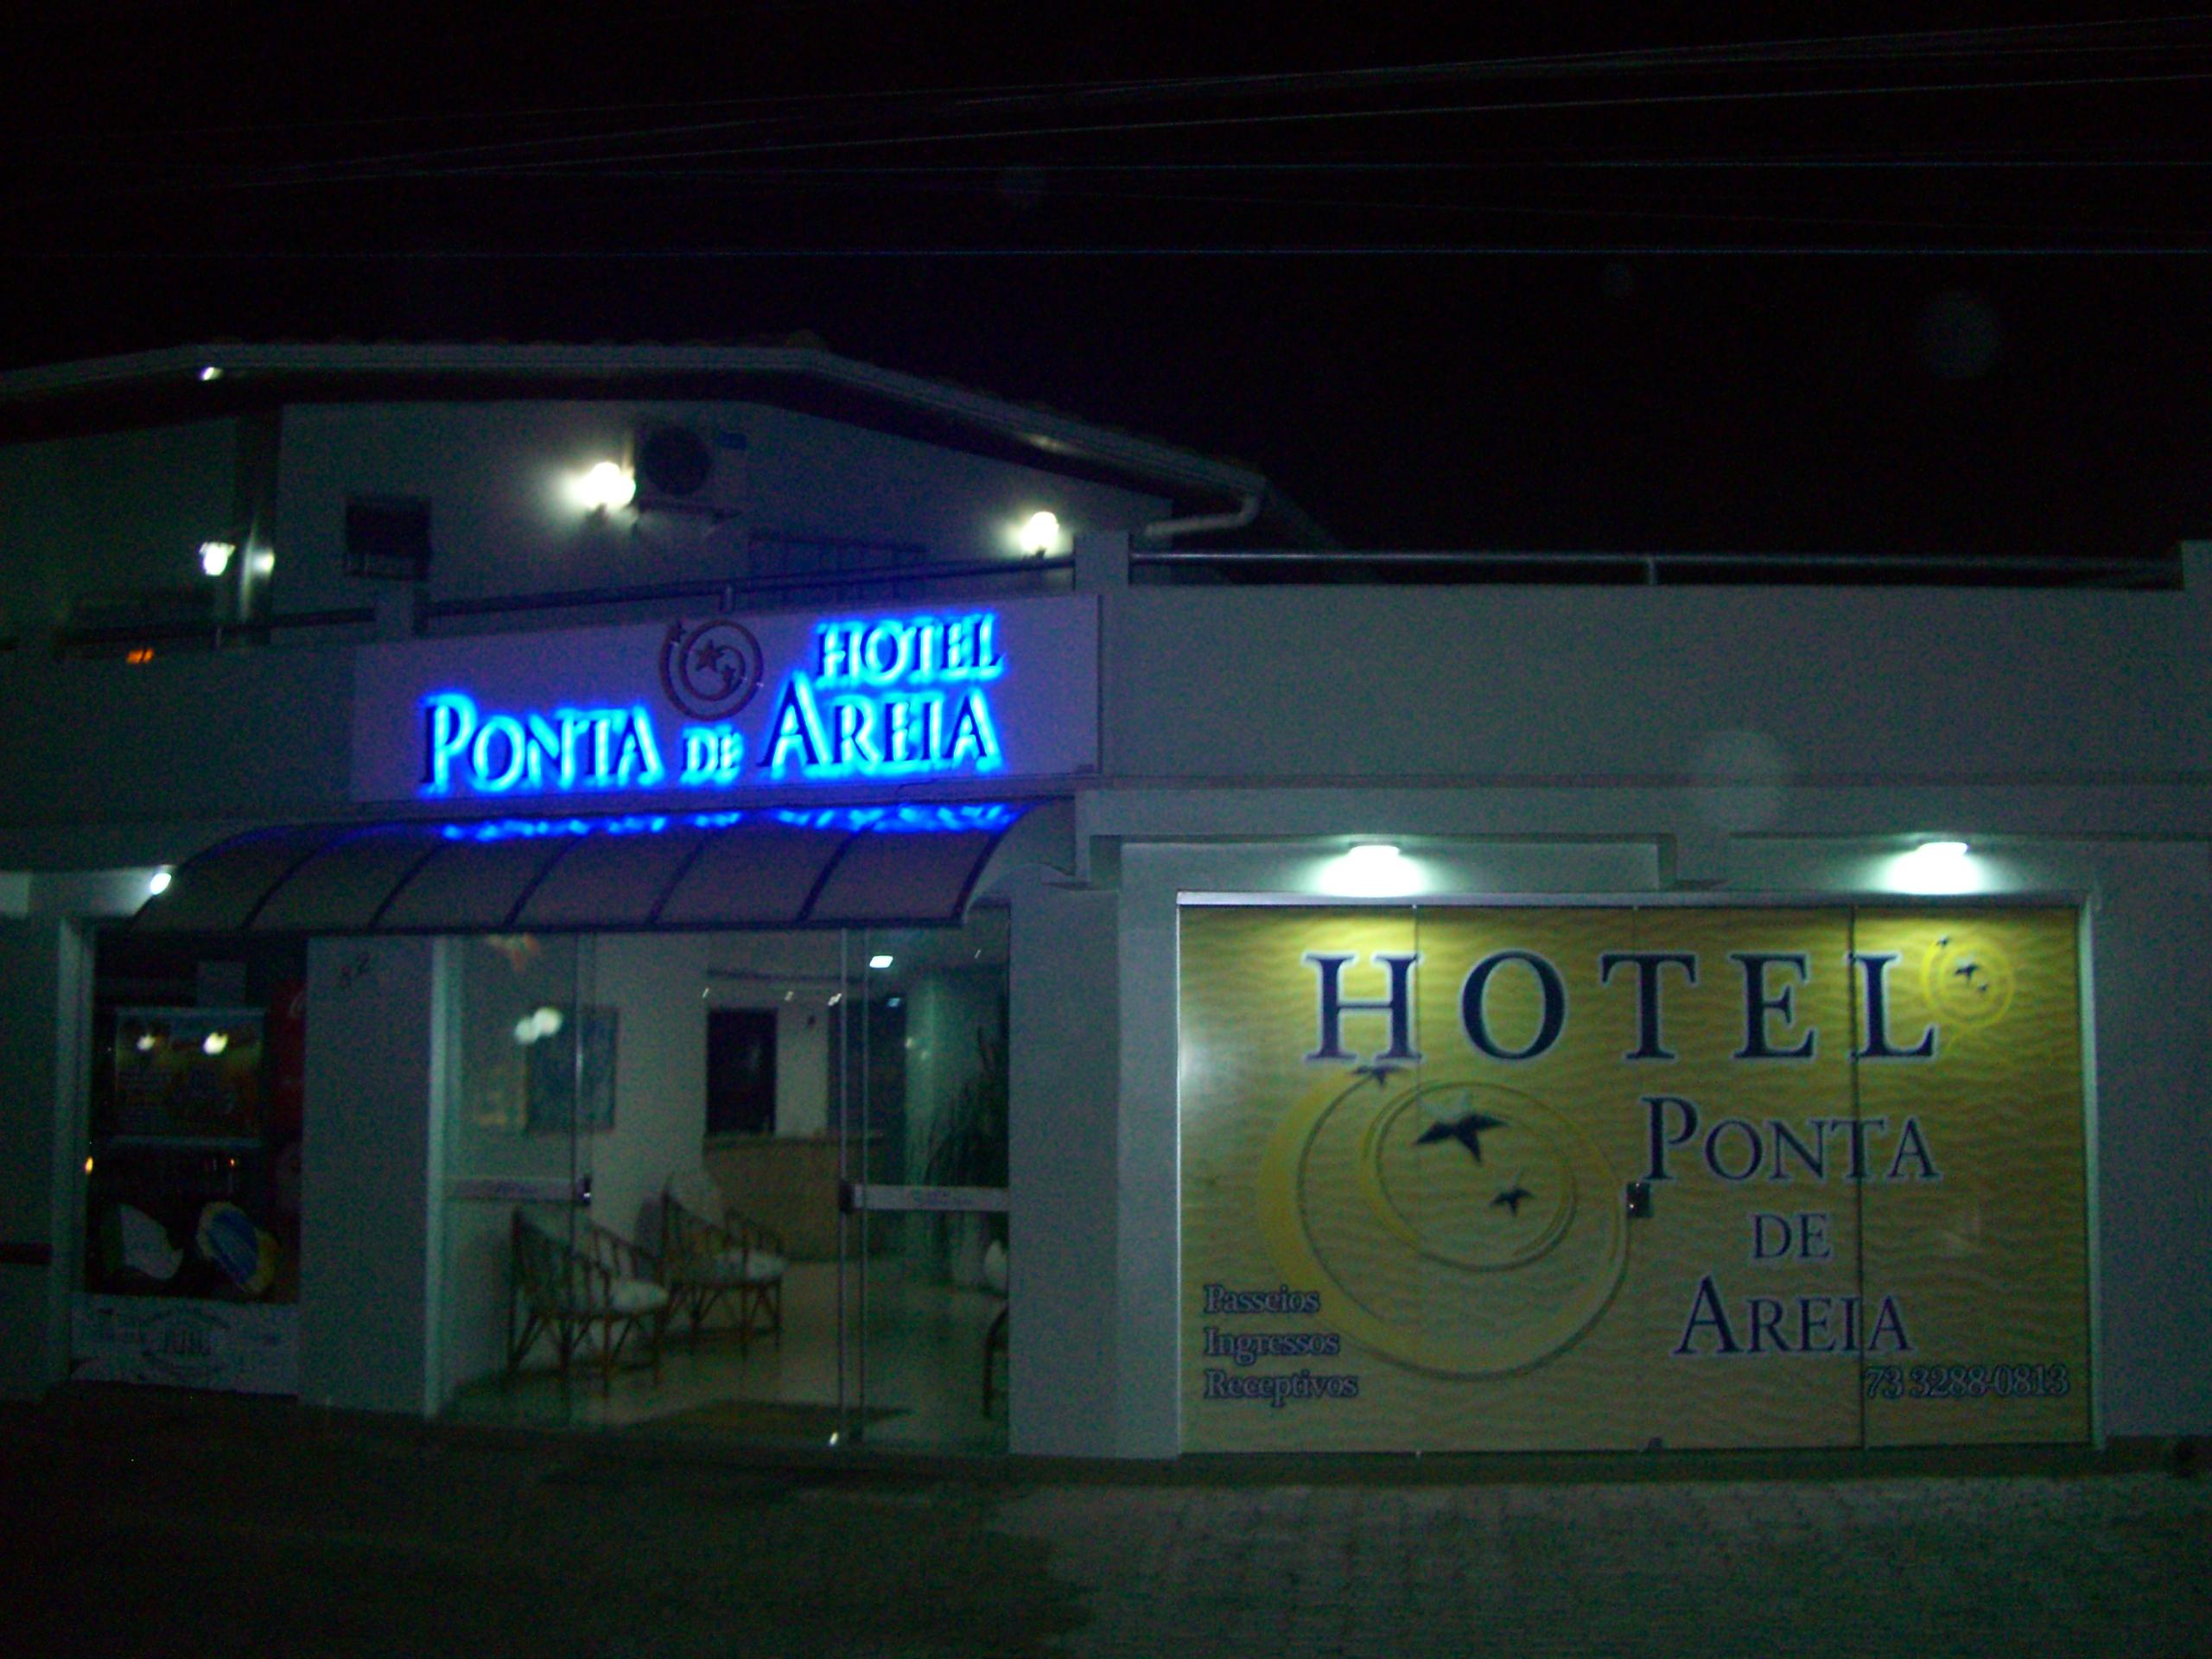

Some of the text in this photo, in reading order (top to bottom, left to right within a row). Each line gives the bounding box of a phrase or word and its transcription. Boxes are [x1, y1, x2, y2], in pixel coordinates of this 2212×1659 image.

[817, 614, 1003, 683] HOTEL
[422, 671, 1003, 792] PONTA DE AREIA
[1303, 951, 1934, 1060] HOTEL
[1642, 1096, 1938, 1180] PONTA
[1754, 1213, 1830, 1259] DE
[1204, 1284, 1319, 1313] Passeios
[1674, 1276, 1911, 1354] AREIA
[1204, 1326, 1340, 1365] Ingressos
[1204, 1369, 1359, 1408] Receptivos
[1863, 1364, 1904, 1399] 73
